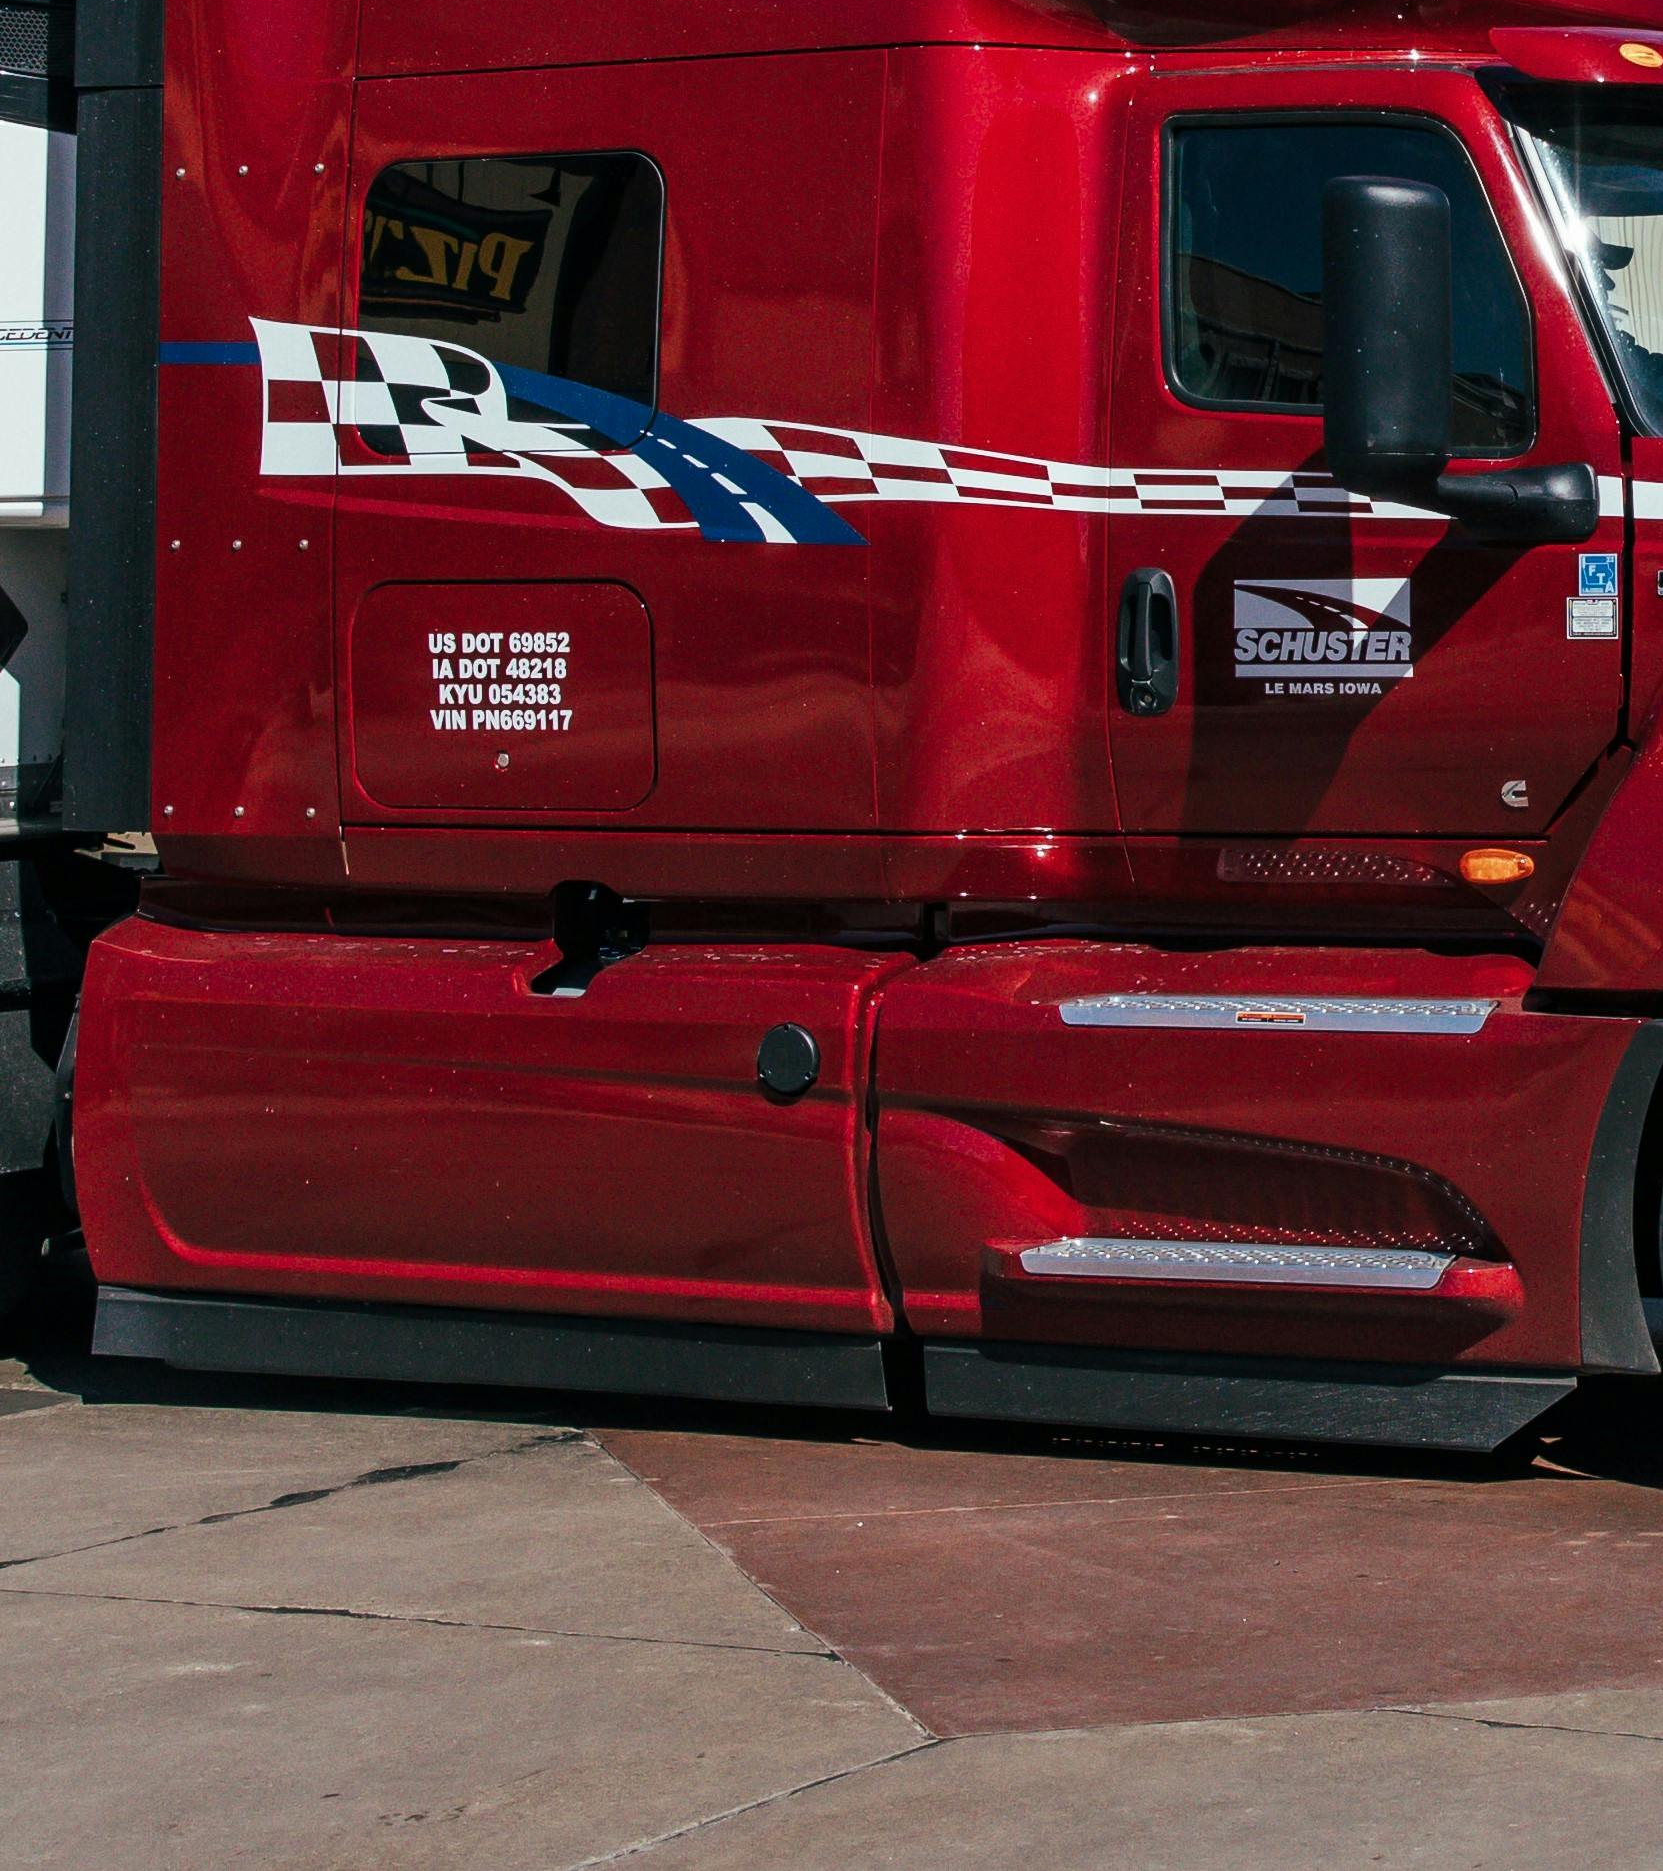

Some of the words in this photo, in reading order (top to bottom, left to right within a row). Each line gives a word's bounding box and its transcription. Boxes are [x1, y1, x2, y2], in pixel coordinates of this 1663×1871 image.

[429, 633, 456, 653] US
[462, 633, 501, 653] DOT
[508, 633, 569, 653] 69852
[1234, 628, 1412, 662] SCHUSTER
[432, 659, 453, 678] IA
[459, 658, 498, 678] DOT
[505, 658, 566, 678] 48218
[439, 684, 483, 704] KYU
[488, 684, 560, 704] 054383
[1265, 681, 1285, 695] LE
[1290, 681, 1334, 695] MARS
[1339, 681, 1382, 695] IOWA
[430, 710, 466, 728] VIN
[472, 710, 572, 729] PN669117
